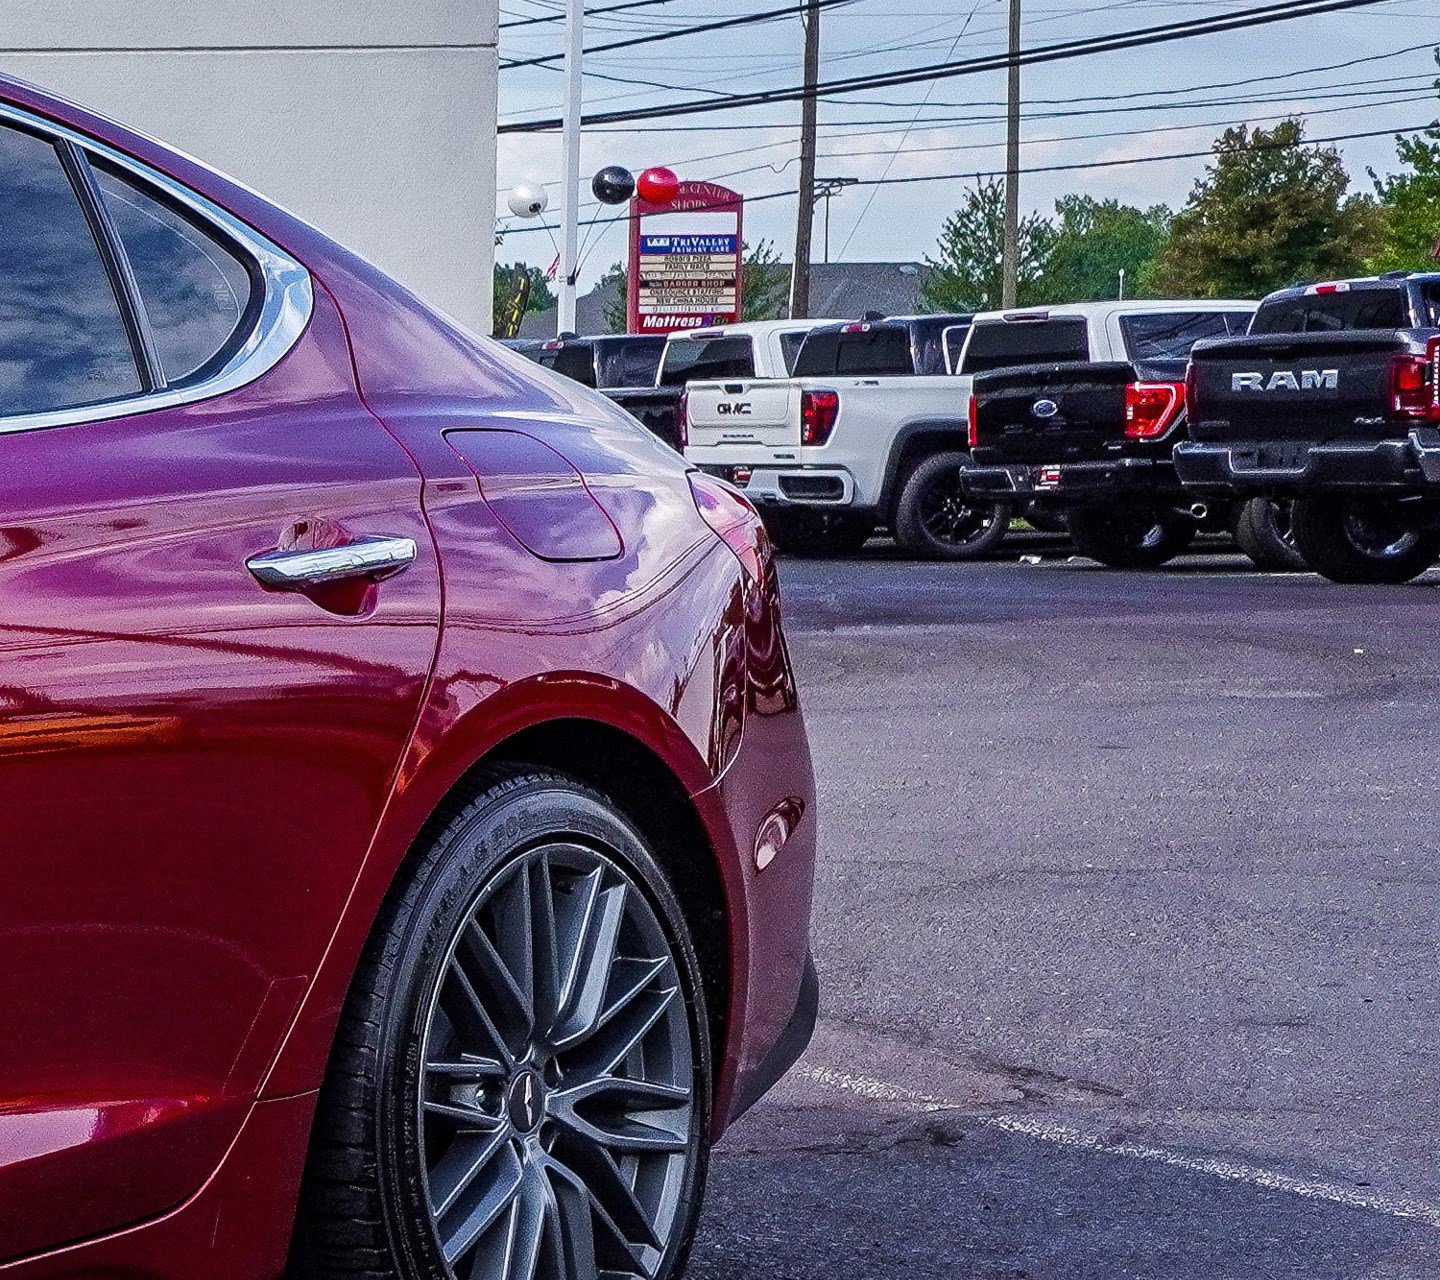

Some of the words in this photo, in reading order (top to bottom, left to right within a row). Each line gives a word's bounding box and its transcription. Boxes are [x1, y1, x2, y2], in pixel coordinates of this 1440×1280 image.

[642, 314, 703, 328] Mattress
[1231, 369, 1339, 391] RAM
[717, 403, 752, 415] GMC
